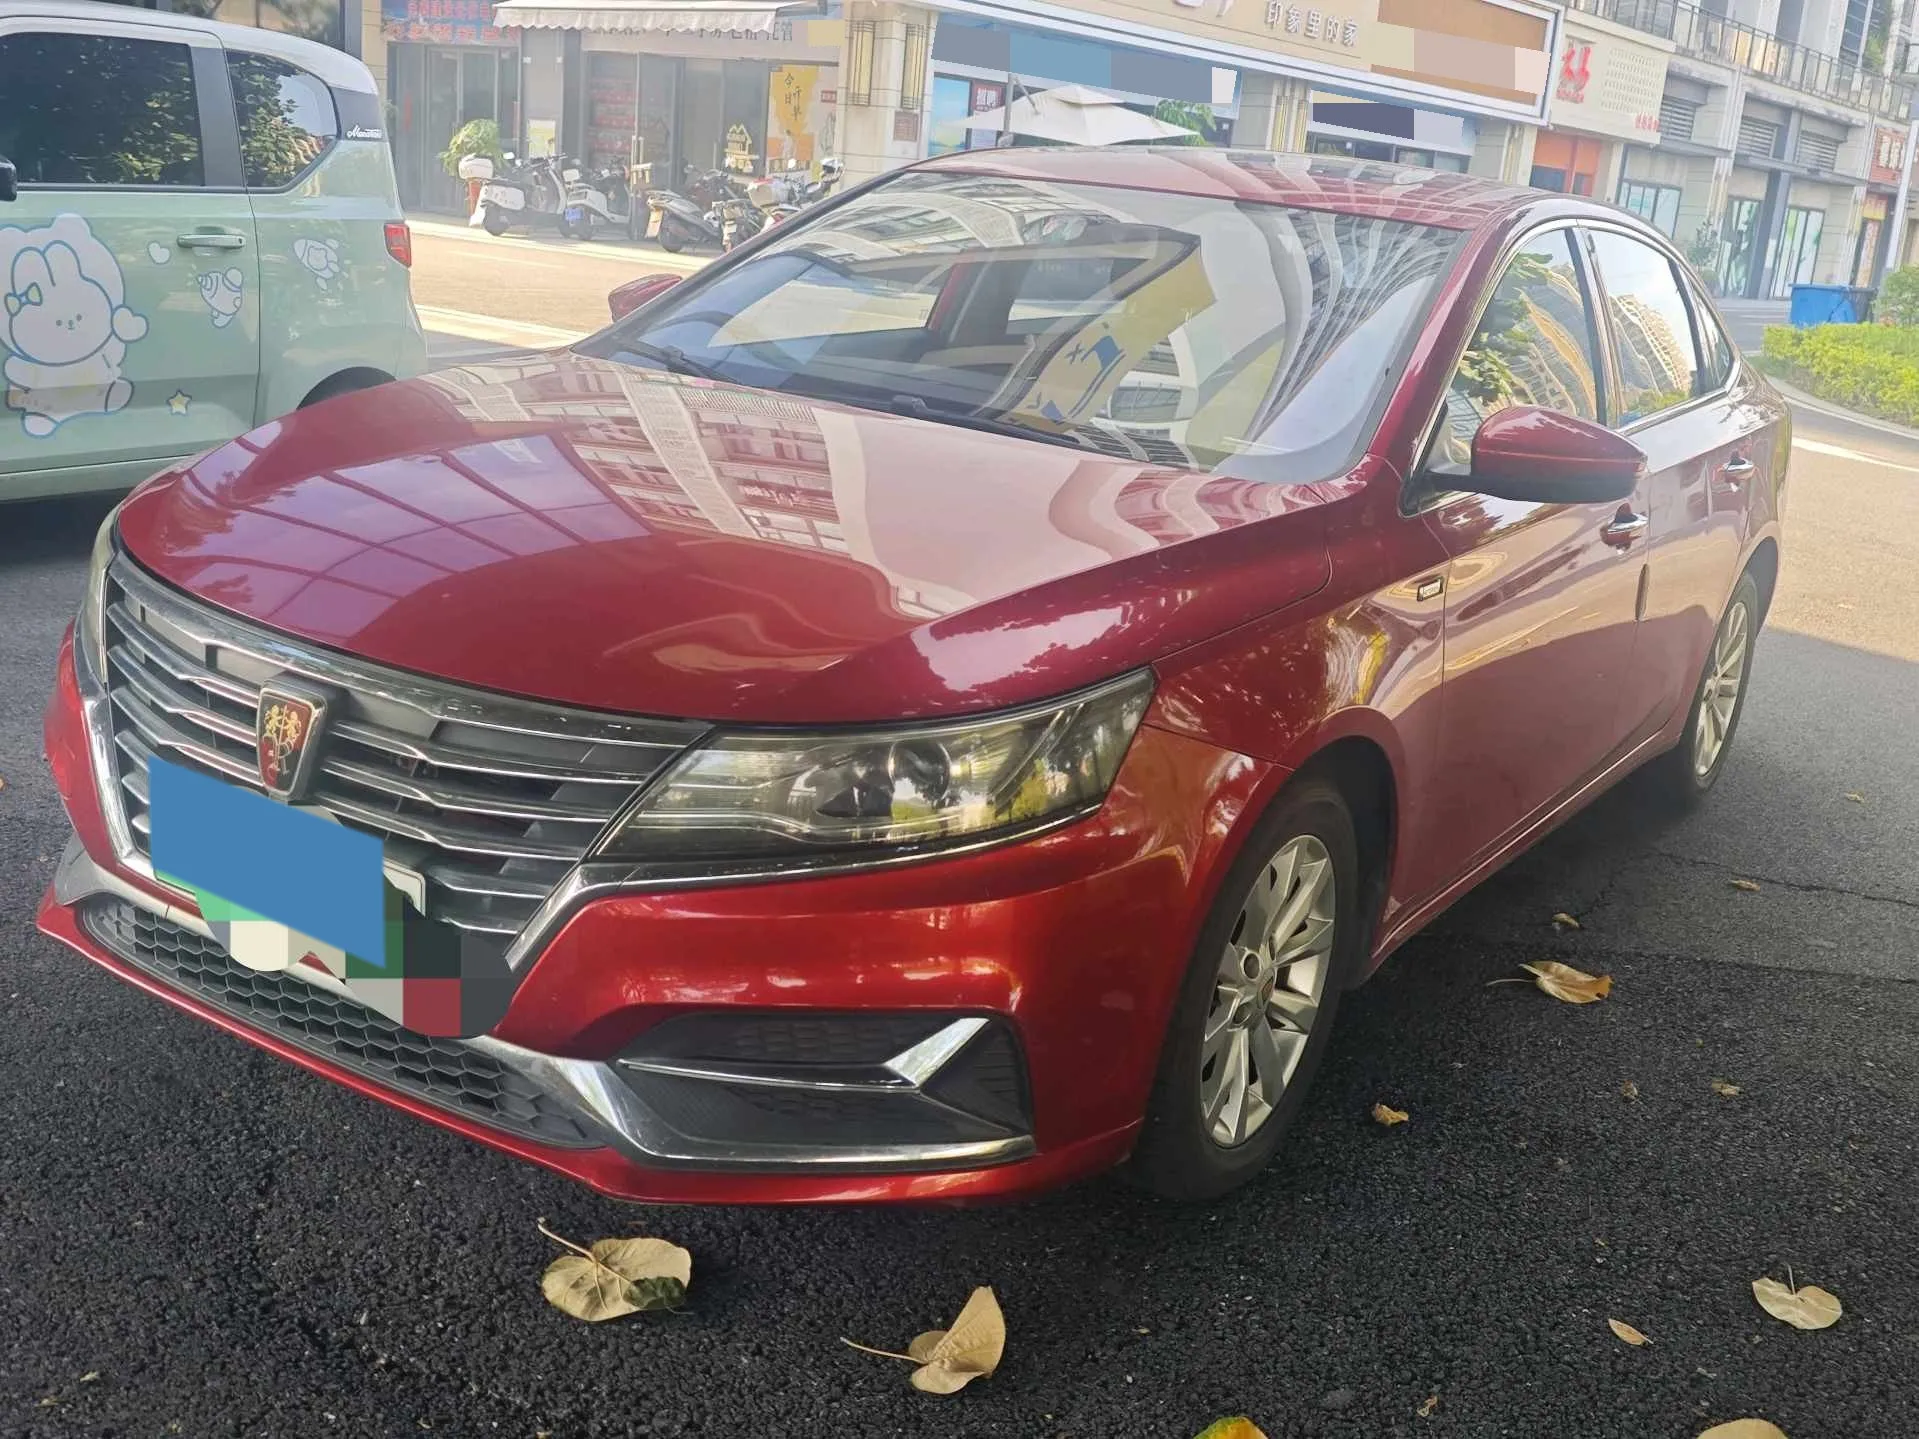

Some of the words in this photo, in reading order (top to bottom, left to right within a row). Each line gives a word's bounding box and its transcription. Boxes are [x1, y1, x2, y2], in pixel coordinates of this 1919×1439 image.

[1265, 0, 1358, 47] 印象里的家
